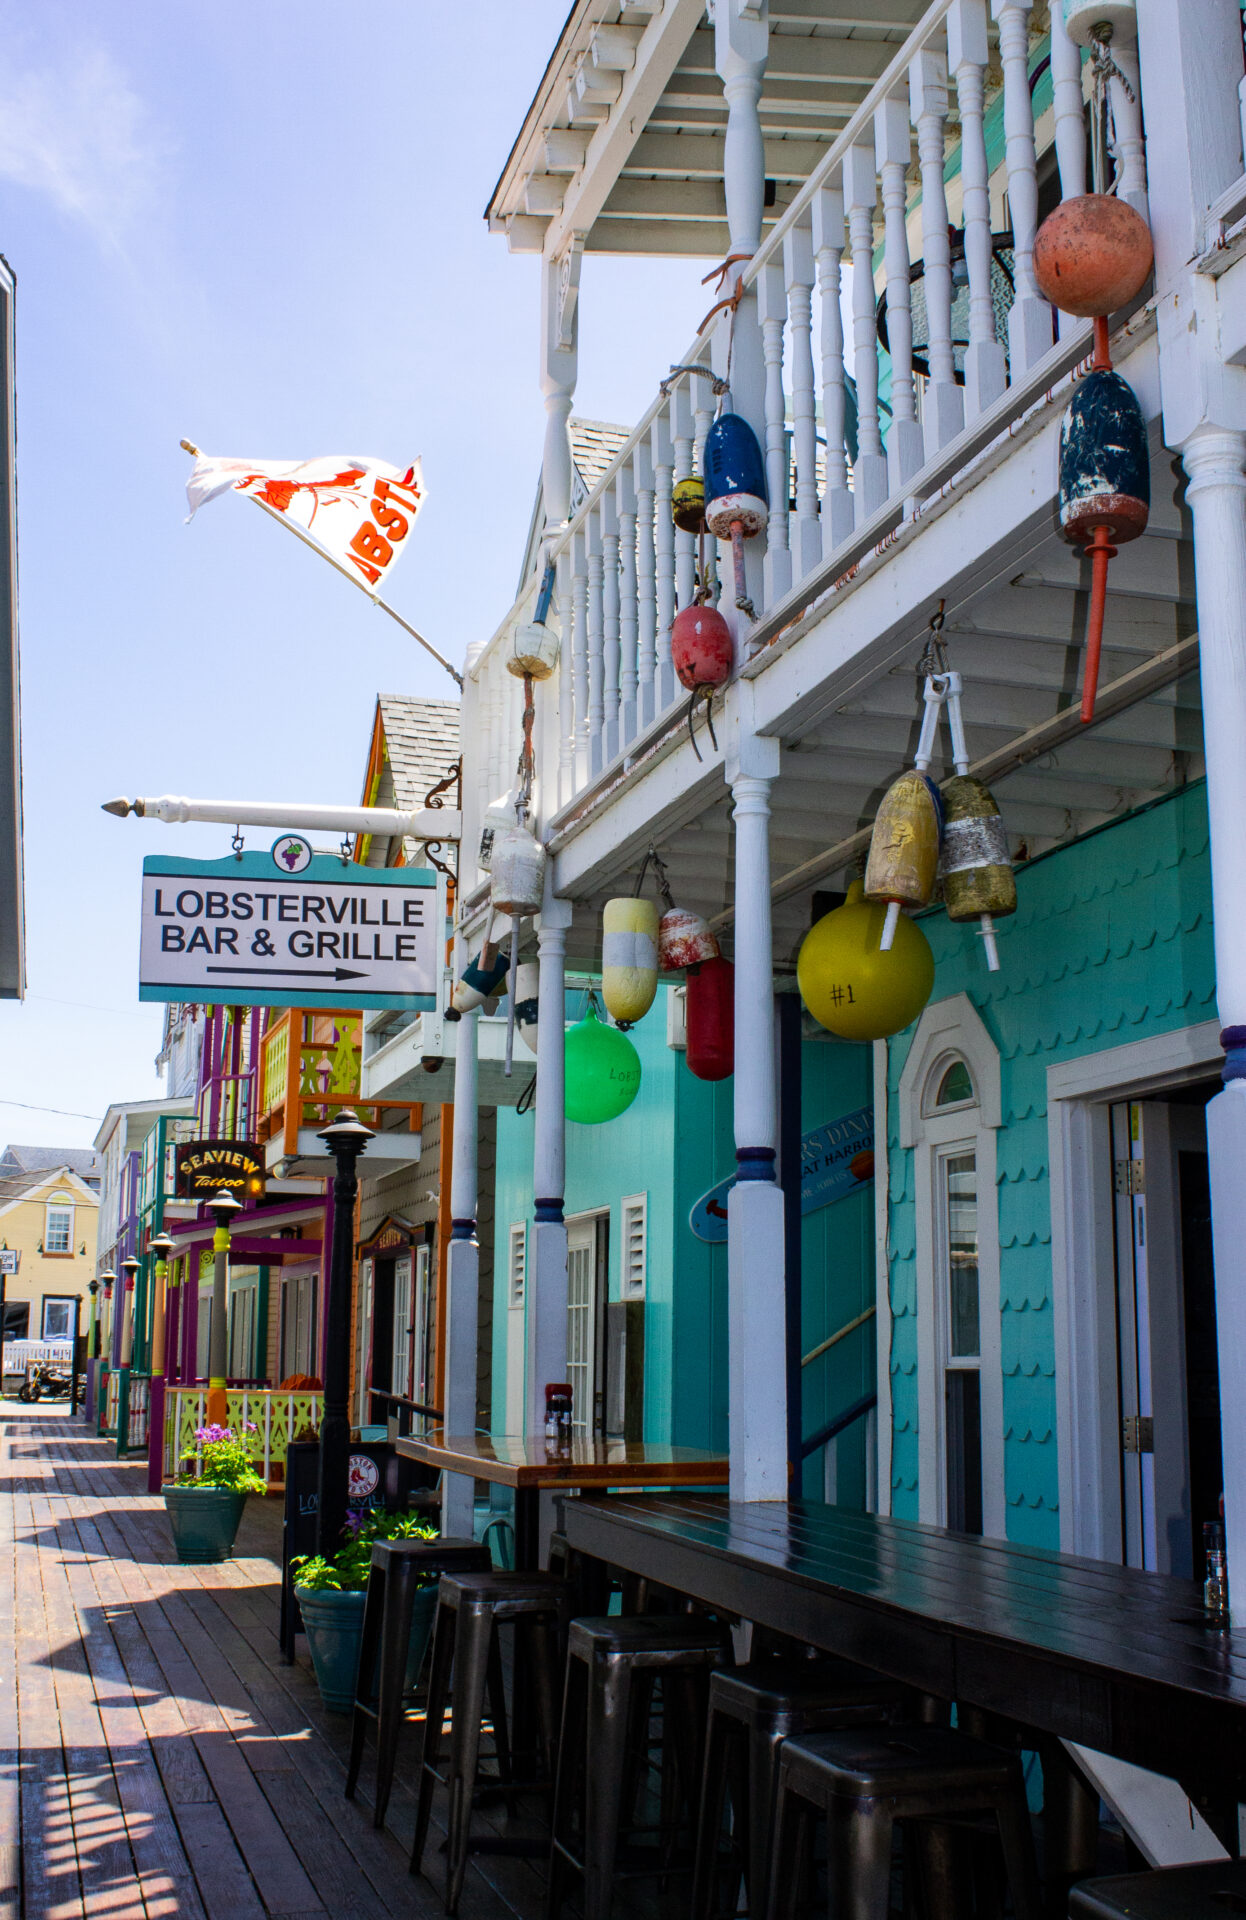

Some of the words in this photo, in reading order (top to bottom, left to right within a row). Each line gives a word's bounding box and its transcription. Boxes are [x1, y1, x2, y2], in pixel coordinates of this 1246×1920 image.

[154, 888, 425, 928] LOBSTERVILLE
[161, 924, 240, 955] BAR
[250, 928, 276, 957] &
[287, 929, 418, 962] GRILLE
[829, 984, 857, 1008] #1
[180, 1150, 260, 1175] SEAVIEW
[824, 1135, 873, 1167] HARBO
[194, 1175, 245, 1188] Tattoo
